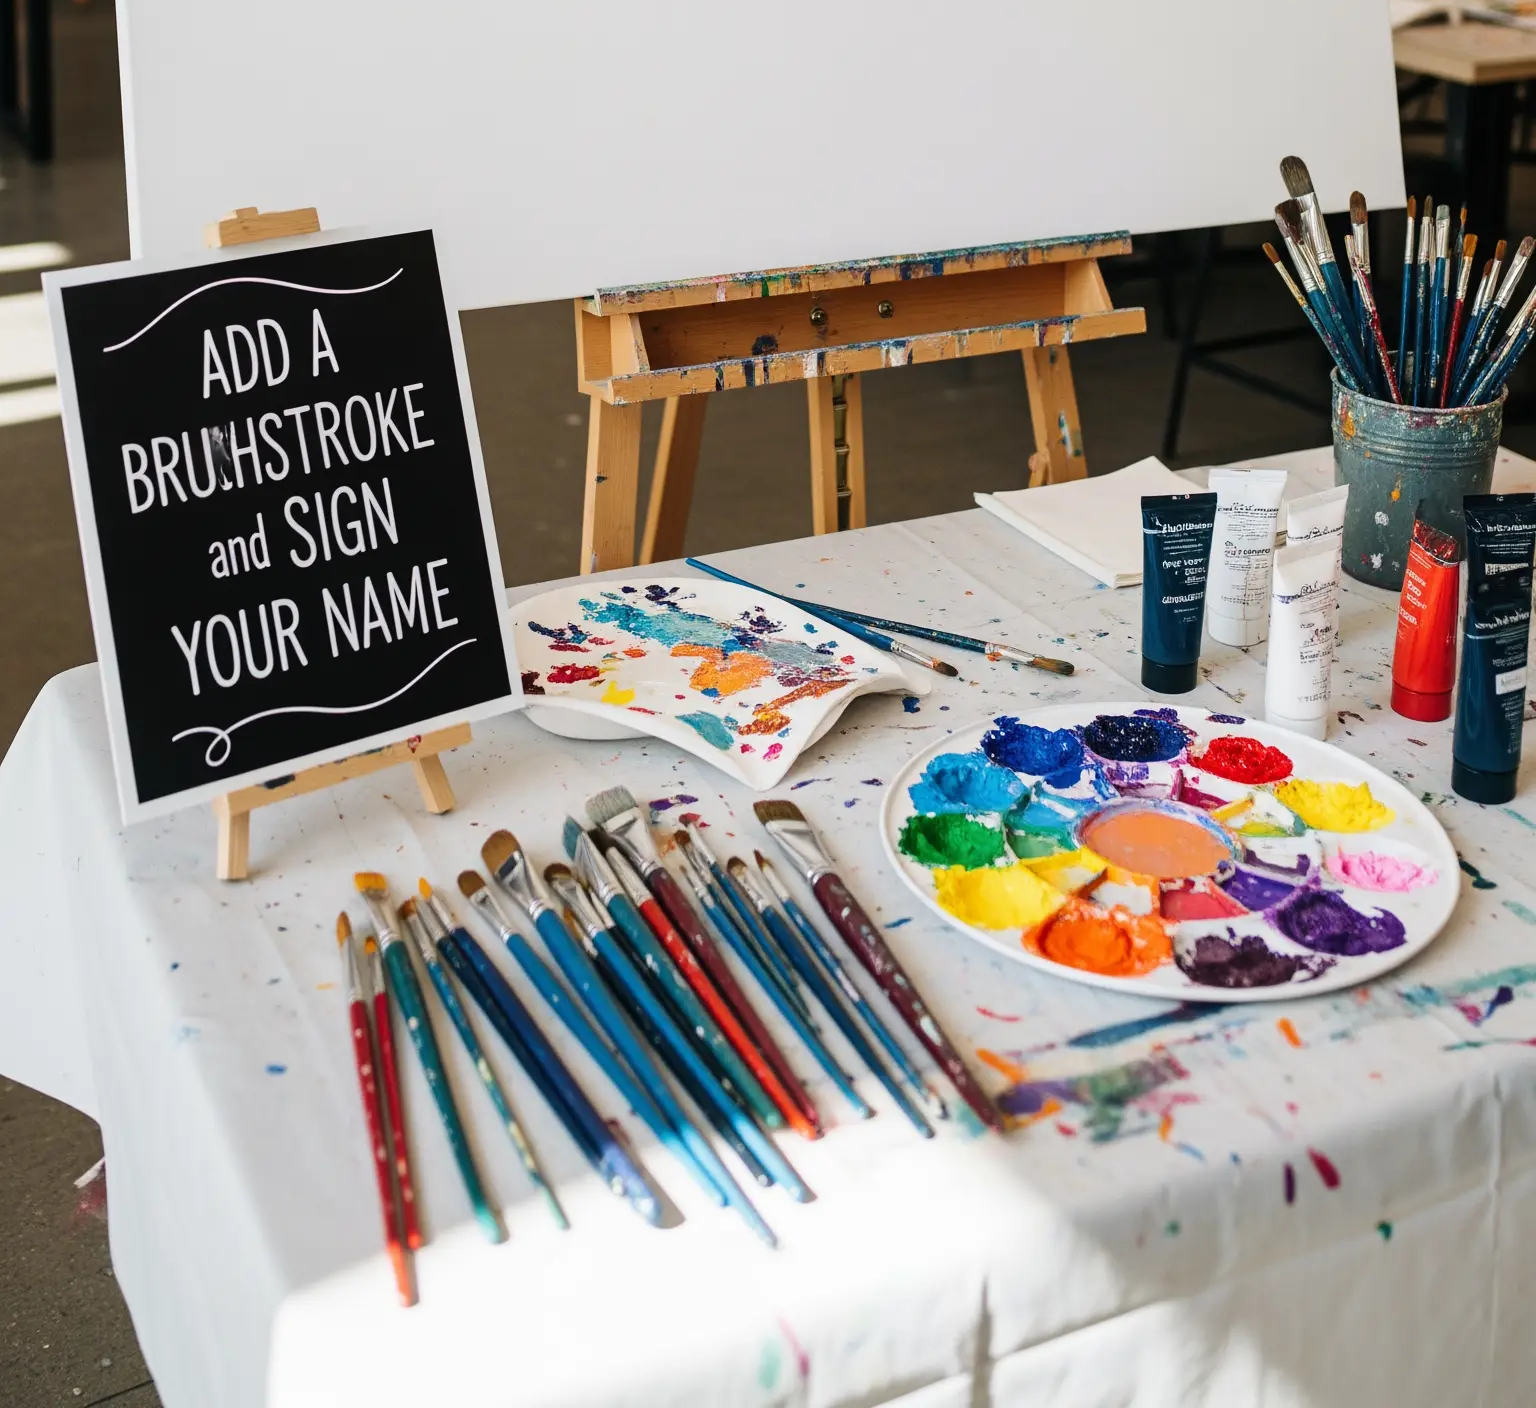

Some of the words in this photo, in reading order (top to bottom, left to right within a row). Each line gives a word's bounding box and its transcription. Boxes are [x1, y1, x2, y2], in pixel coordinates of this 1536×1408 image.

[203, 318, 290, 399] ADD
[313, 308, 340, 377] A
[122, 382, 435, 513] BRUHSTROKE
[208, 512, 271, 579] and
[283, 477, 399, 568] SIGN
[170, 598, 309, 696] YOUR
[322, 558, 459, 658] NAME
